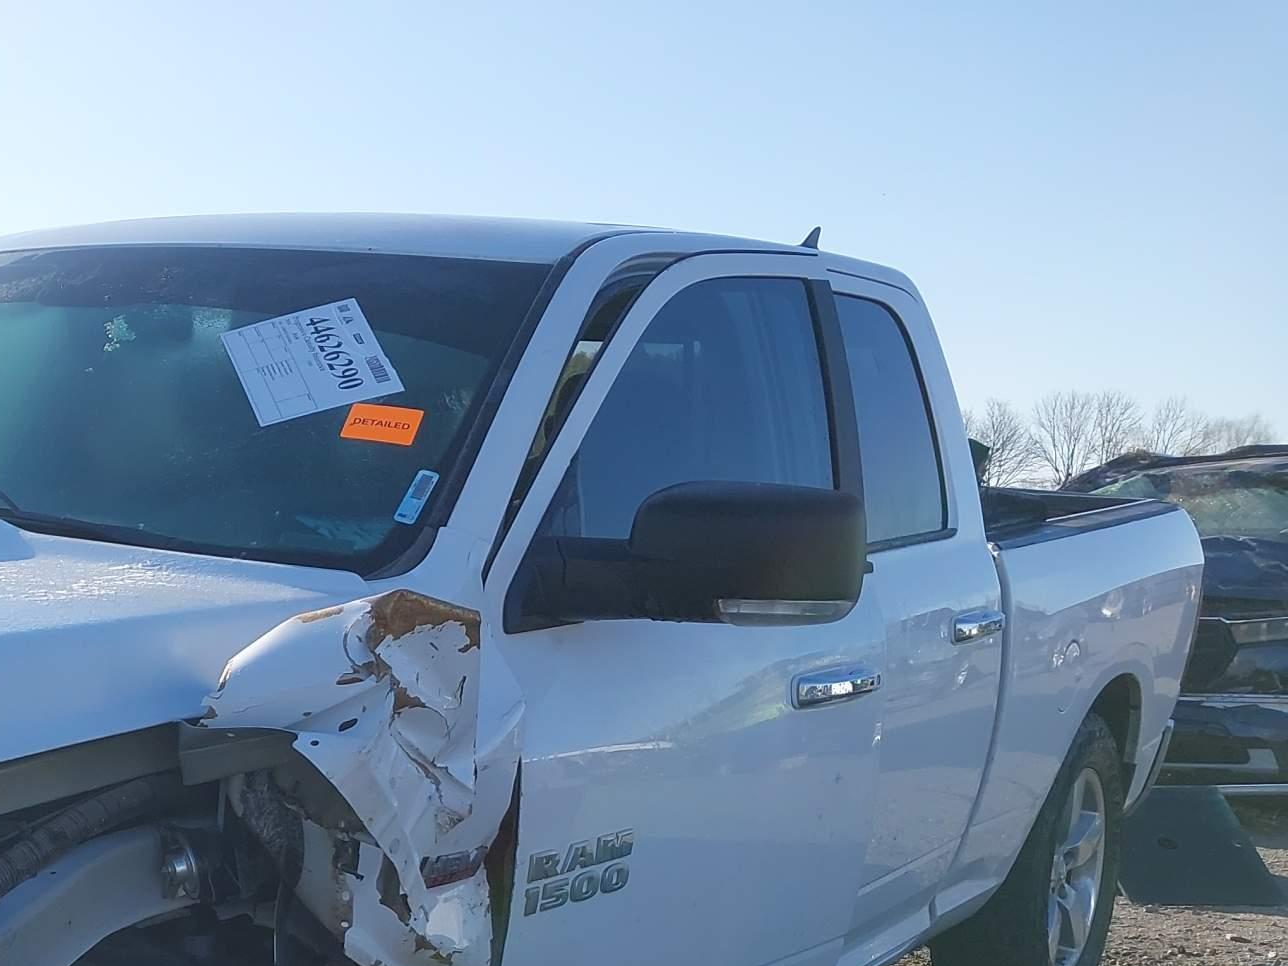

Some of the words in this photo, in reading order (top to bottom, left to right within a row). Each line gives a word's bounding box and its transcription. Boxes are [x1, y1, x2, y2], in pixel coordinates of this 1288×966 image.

[305, 316, 365, 391] 44626290
[351, 416, 411, 431] DETAILED
[527, 828, 635, 884] RAM
[523, 861, 631, 917] 1500
